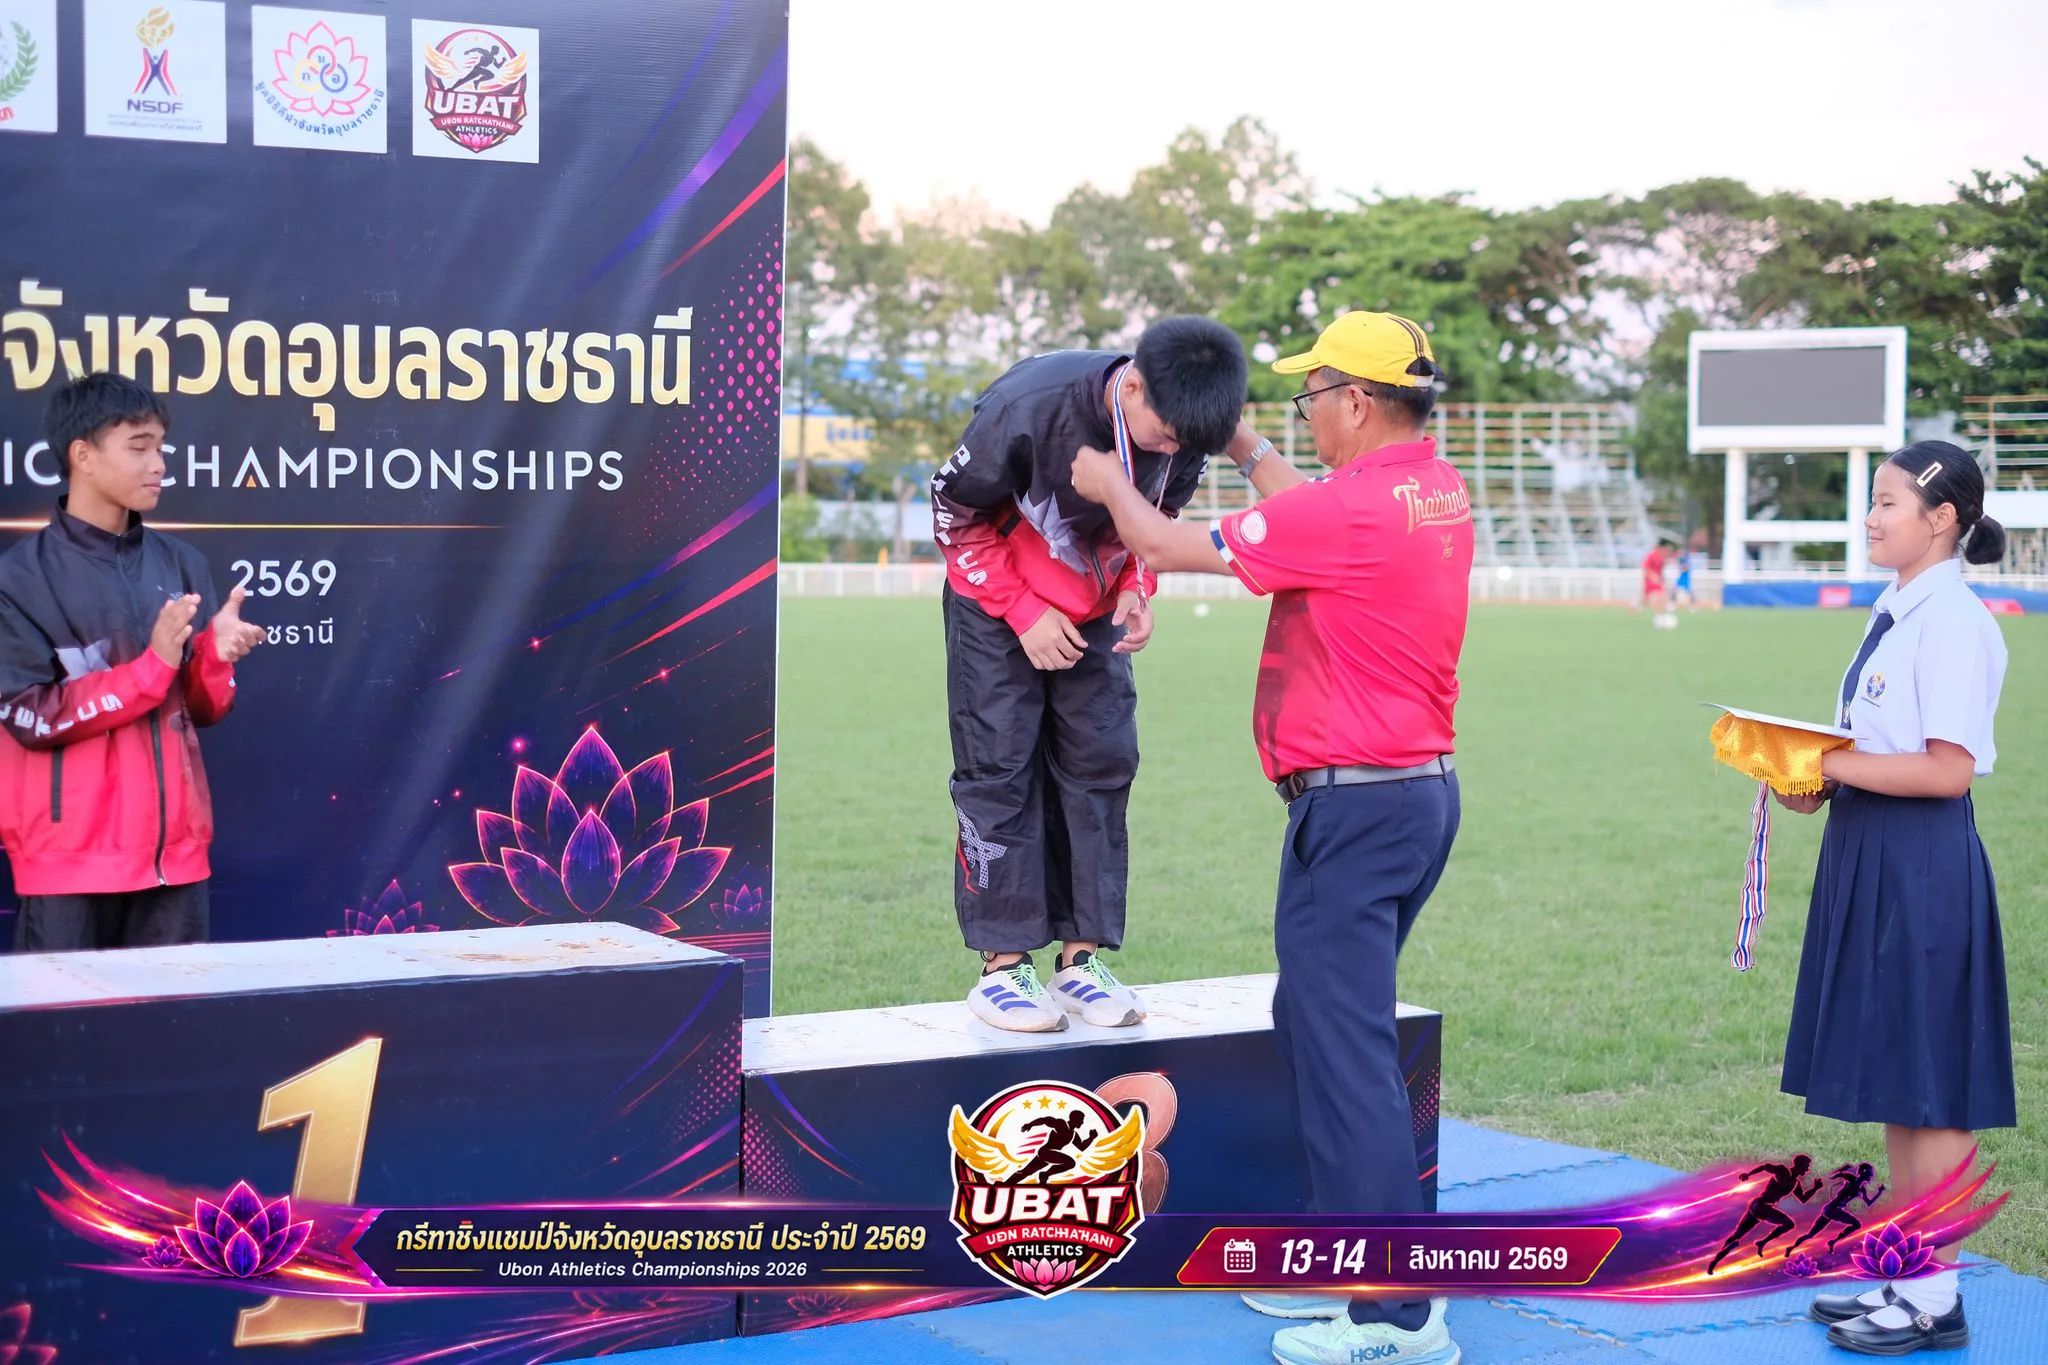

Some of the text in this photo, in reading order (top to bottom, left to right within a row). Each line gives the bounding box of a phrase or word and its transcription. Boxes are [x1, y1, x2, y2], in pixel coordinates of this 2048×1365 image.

[127, 99, 184, 114] NSDF
[433, 90, 520, 119] UBAT
[441, 117, 514, 130] UBON RATCHATHANI
[455, 125, 498, 135] ATHLETICS
[1392, 475, 1470, 535] Thailand
[230, 559, 337, 597] 2569
[257, 617, 334, 645] ชธานี
[235, 1036, 383, 1347] 1
[1350, 1343, 1400, 1364] HOKA
